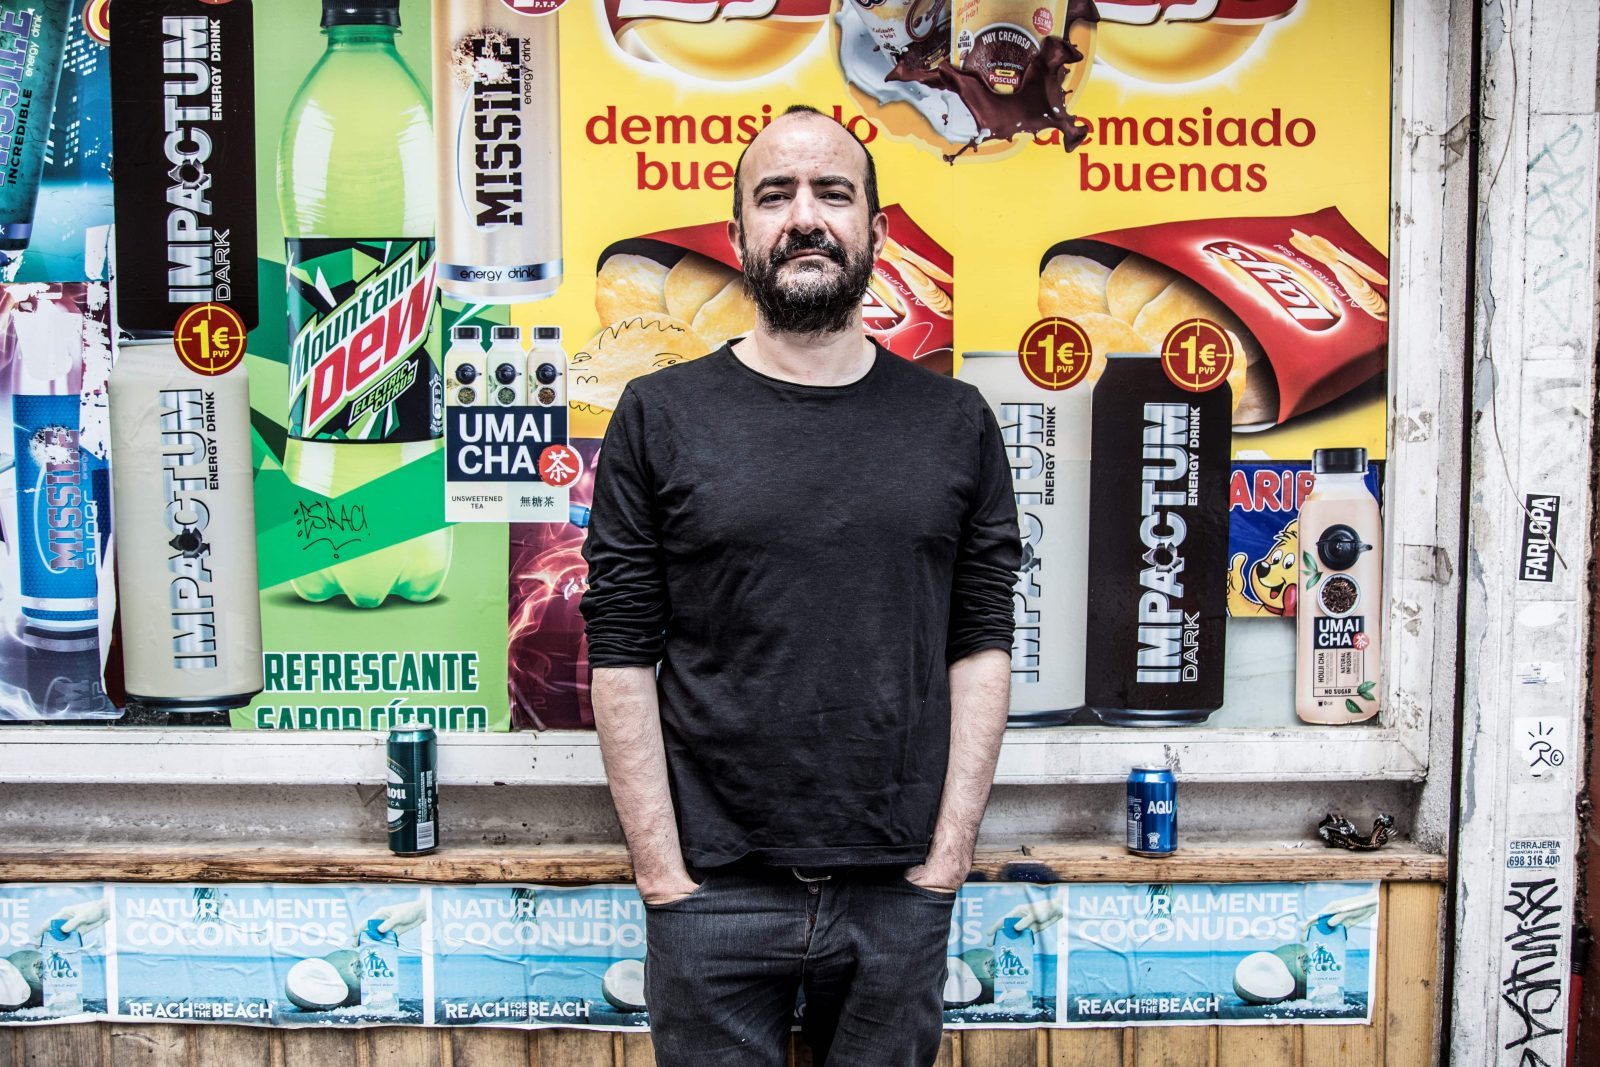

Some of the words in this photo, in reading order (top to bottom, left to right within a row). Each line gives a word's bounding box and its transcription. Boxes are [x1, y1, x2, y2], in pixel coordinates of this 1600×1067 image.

[32, 14, 43, 38] drink
[211, 19, 222, 61] DRINK
[982, 31, 997, 46] MUY
[998, 31, 1031, 50] CREMOSO
[25, 42, 41, 77] energy
[522, 38, 531, 62] drink
[211, 67, 223, 121] ENERGY
[523, 66, 534, 105] energy
[989, 74, 1019, 85] Pascual
[7, 88, 33, 186] INCREDIBLE
[162, 16, 214, 303] IMPACTUM
[1079, 152, 1268, 193] buenas
[214, 229, 232, 302] DARK
[460, 268, 502, 282] energy
[508, 267, 536, 280] drink
[1313, 268, 1347, 297] Punto
[290, 256, 414, 392] Mountain
[212, 350, 230, 358] PVP
[1056, 365, 1074, 374] PVP
[1198, 366, 1216, 375] PVP
[353, 364, 409, 417] ELECTRIC
[374, 369, 415, 412] CITRUS
[205, 391, 216, 432] DRINK
[1046, 406, 1057, 446] DRINK
[1188, 406, 1201, 449] DRINK
[458, 413, 552, 443] UMAI
[207, 438, 219, 490] ENERGY
[457, 444, 536, 475] CHA
[544, 449, 577, 483] 茶
[1045, 452, 1056, 505] ENERGY
[1187, 452, 1200, 507] ENERGY
[520, 495, 555, 508] 無糖茶
[159, 388, 218, 670] IMPACTUM
[1136, 402, 1190, 683] IMPACTUM
[1524, 497, 1554, 580] FARLOPA
[1318, 632, 1352, 647] CHA
[1319, 618, 1360, 632] UMAI
[1182, 611, 1200, 682] DARK
[263, 651, 480, 693] REFRESCANTE
[1146, 800, 1173, 815] AQU
[1509, 855, 1525, 866] 698
[1527, 855, 1543, 866] 316
[126, 897, 347, 919] NATURALMENTE
[1079, 893, 1299, 916] NATURALMENTE
[126, 920, 349, 947] COCONUDOS
[1078, 916, 1300, 944] COCONUDOS
[130, 1002, 194, 1018] REACH
[194, 1010, 211, 1018] THE
[212, 1002, 273, 1019] BEACH
[445, 1002, 510, 1018] REACH
[510, 1009, 527, 1017] THE
[529, 1002, 590, 1018] BEACH
[1078, 999, 1140, 1015] REACH
[1140, 1006, 1158, 1014] THE
[1158, 998, 1220, 1014] BEACH
